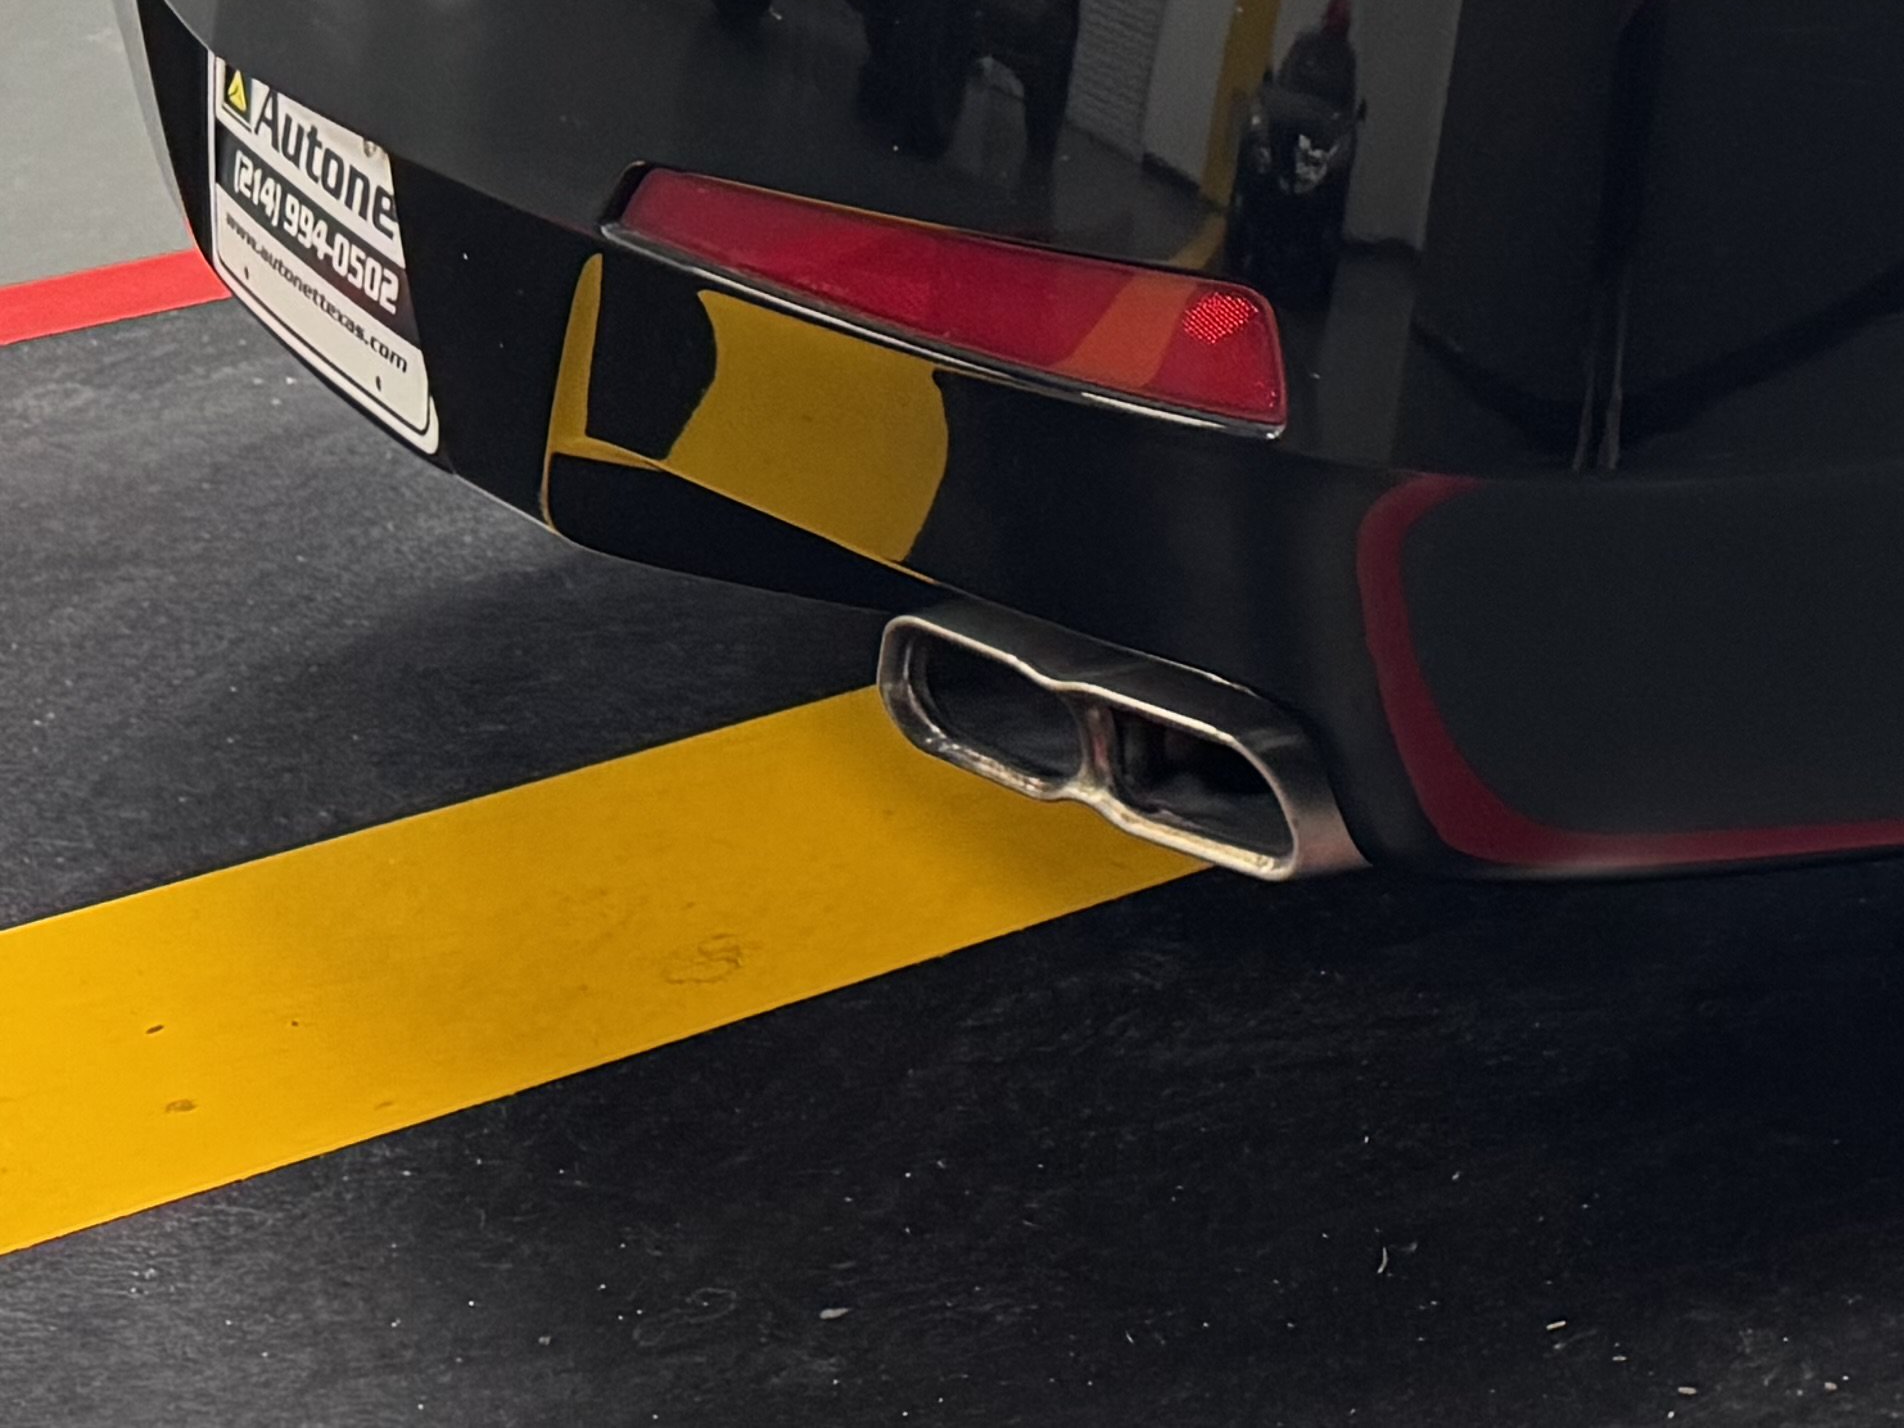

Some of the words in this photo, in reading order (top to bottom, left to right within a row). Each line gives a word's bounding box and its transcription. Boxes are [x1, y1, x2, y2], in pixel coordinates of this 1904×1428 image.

[226, 210, 408, 373] www.autonettexas.com
[234, 149, 282, 227] (214)
[283, 197, 399, 315] 994-0502
